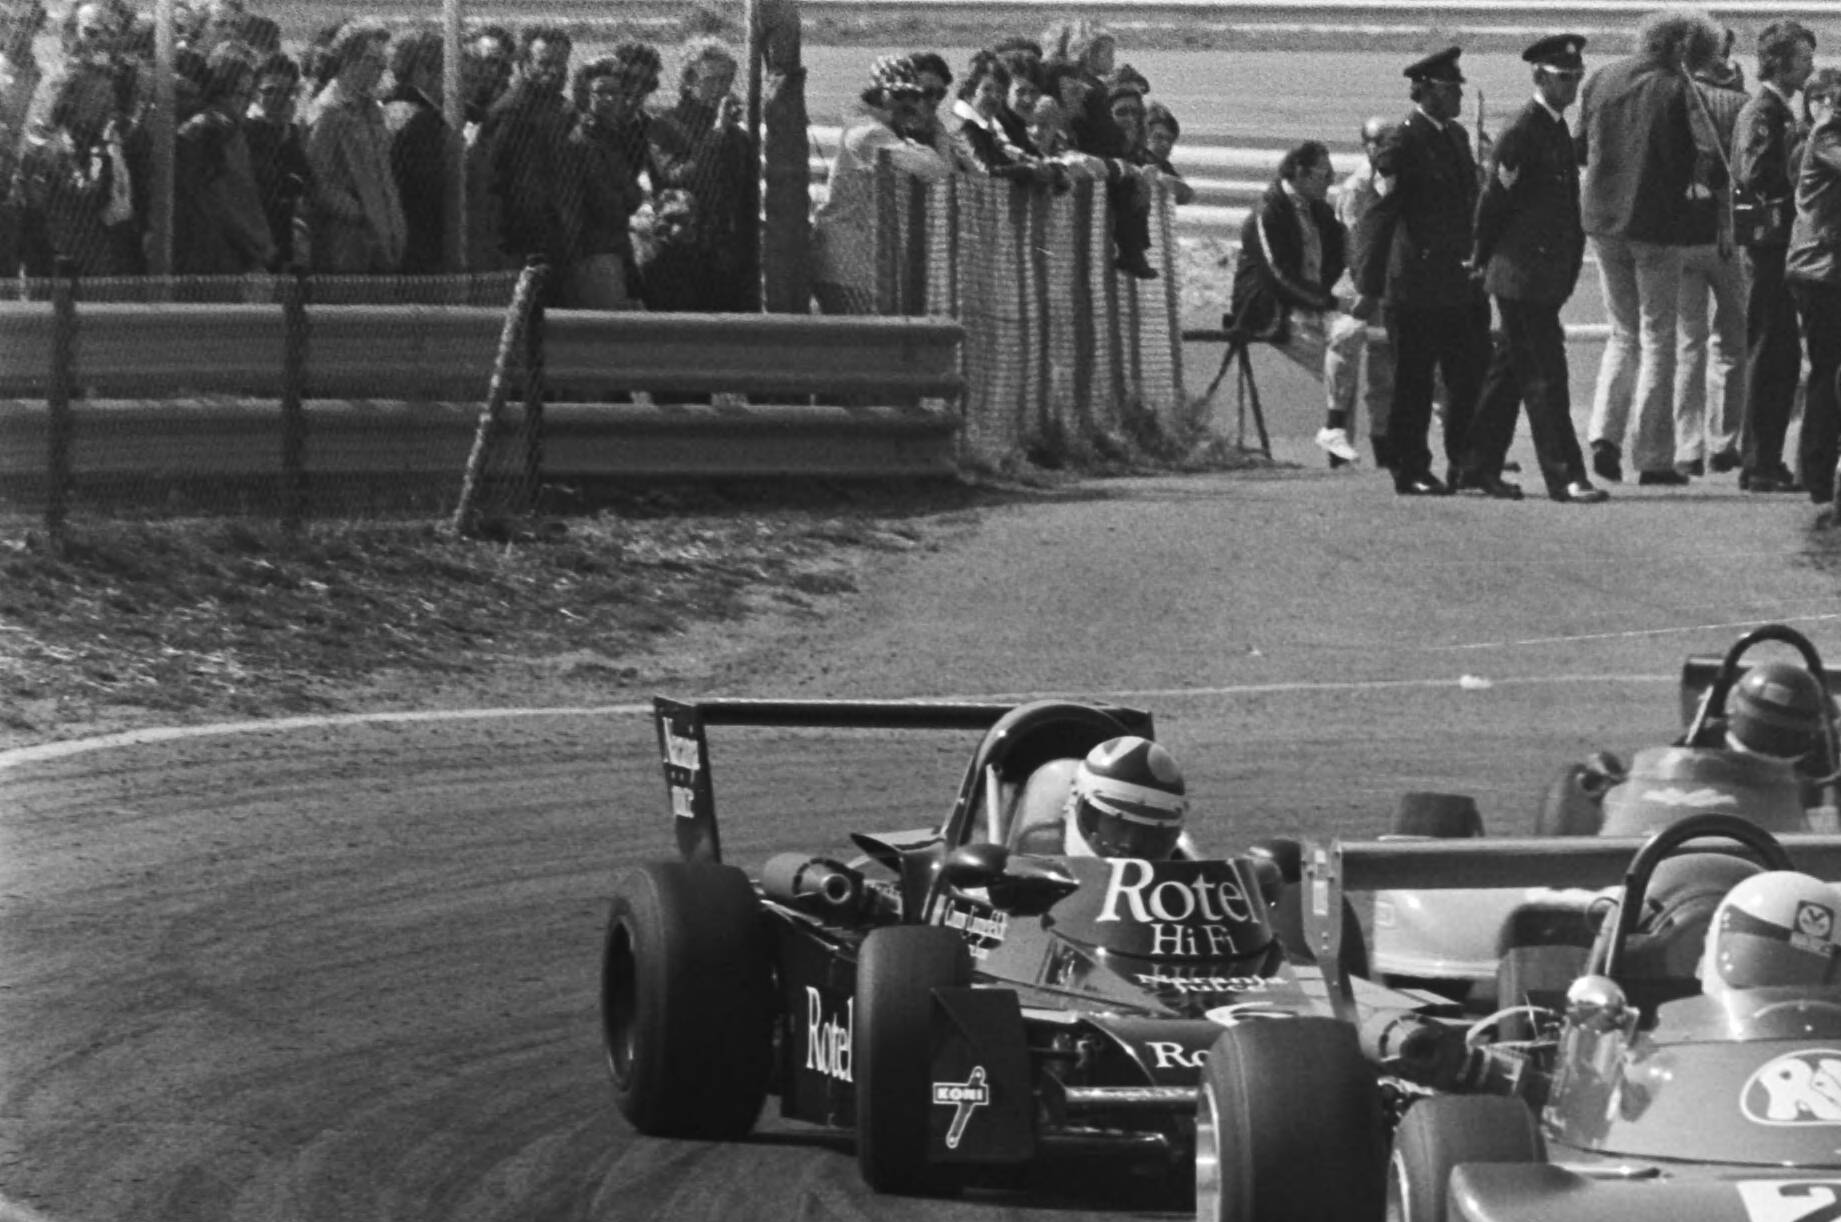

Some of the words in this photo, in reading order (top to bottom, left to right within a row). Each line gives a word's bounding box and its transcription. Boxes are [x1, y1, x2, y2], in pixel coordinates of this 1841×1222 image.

[1095, 857, 1261, 923] Rotel
[1151, 923, 1199, 956] Hi
[1202, 924, 1239, 955] Fi
[806, 985, 853, 1083] Rotel
[937, 1086, 983, 1101] KONI
